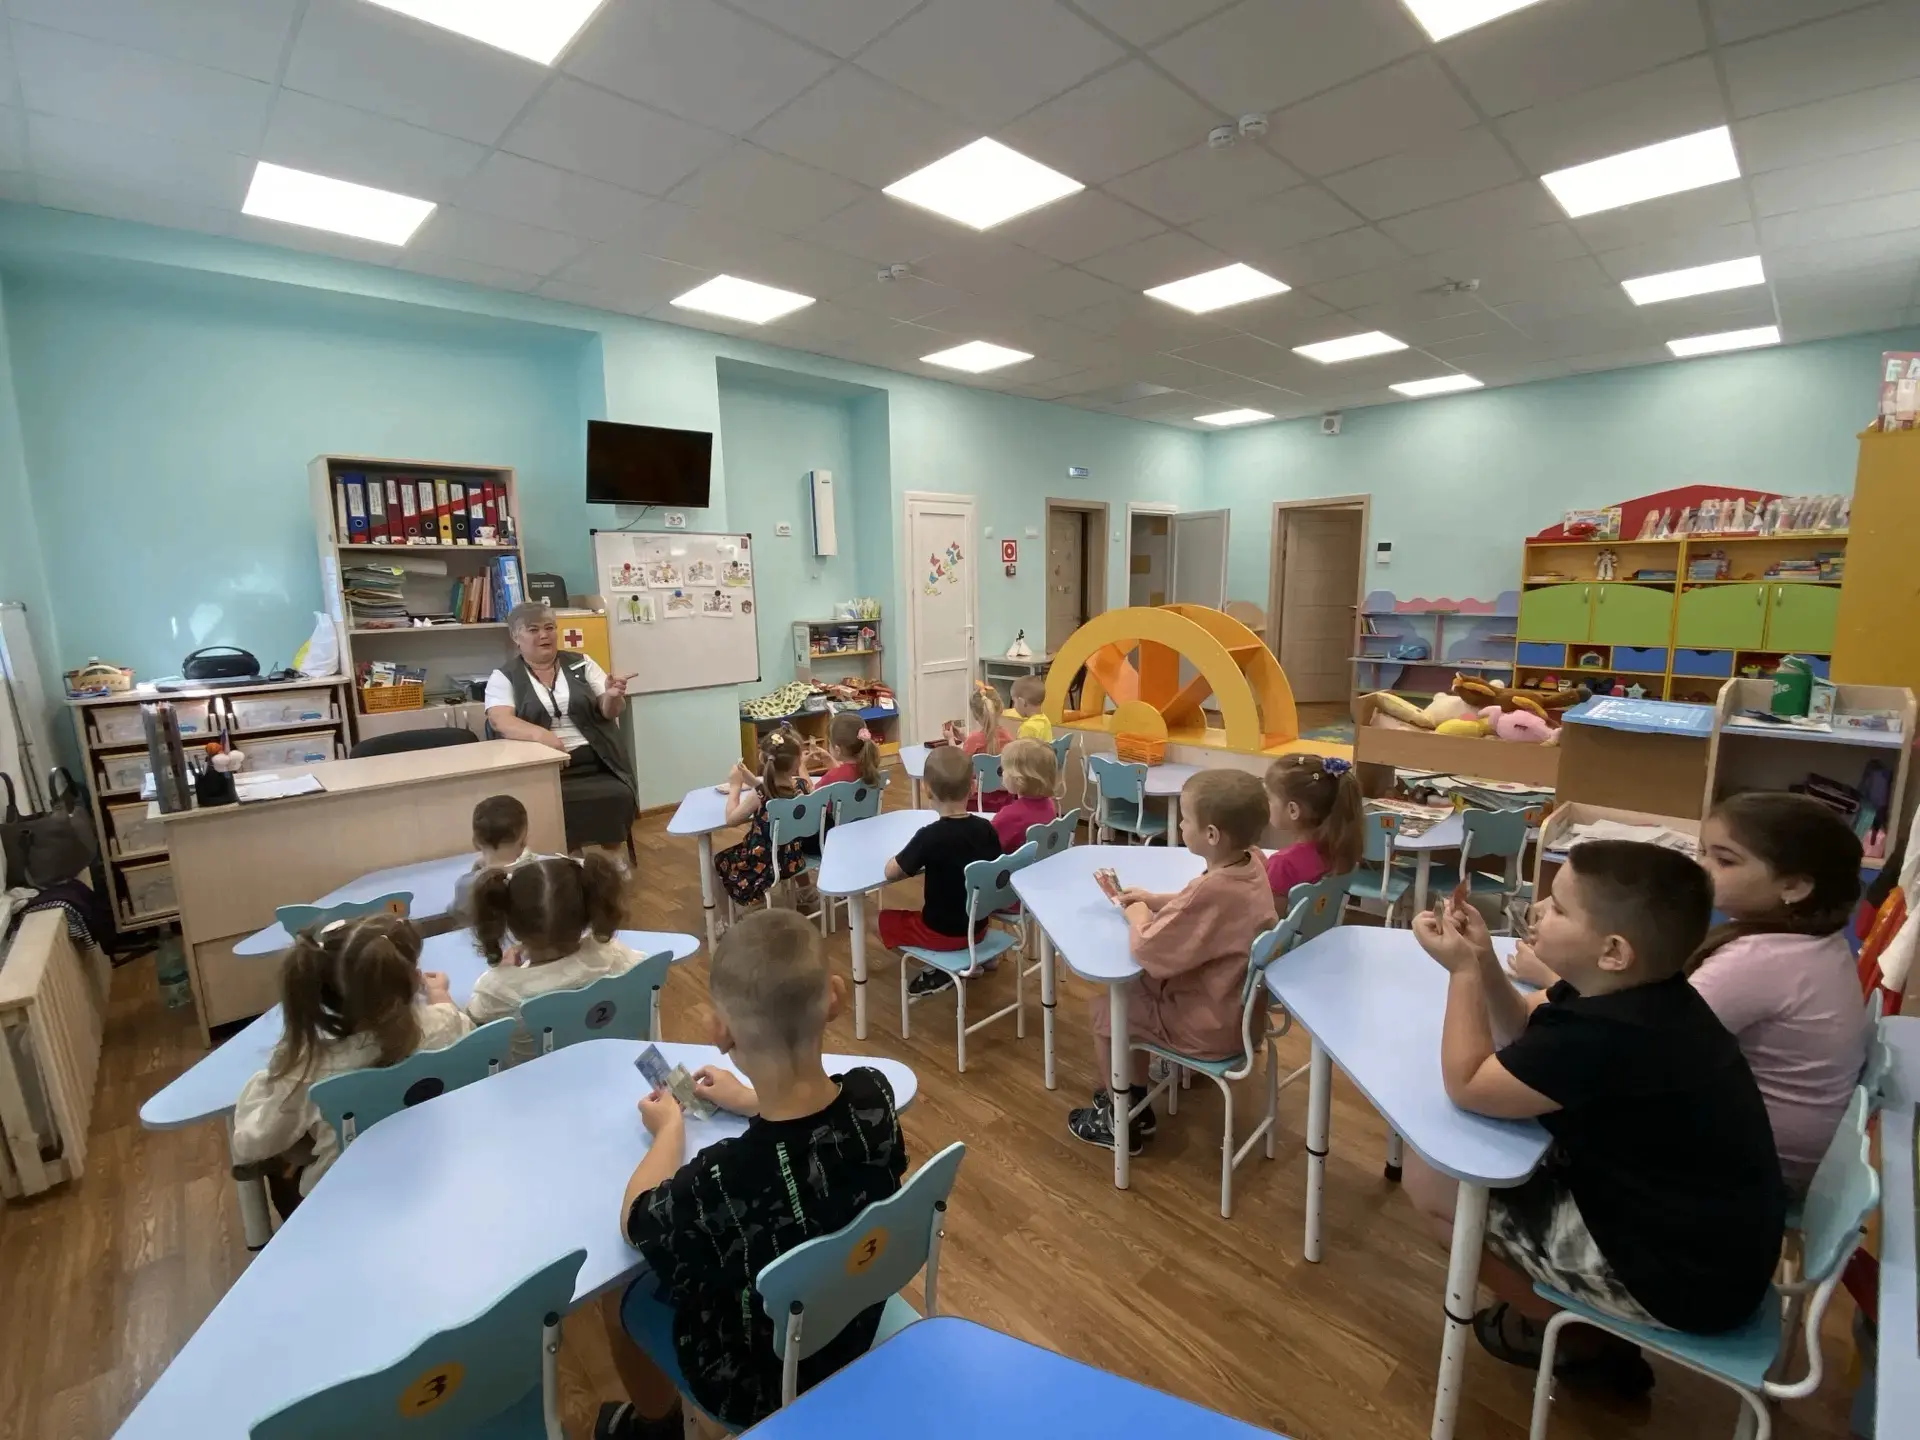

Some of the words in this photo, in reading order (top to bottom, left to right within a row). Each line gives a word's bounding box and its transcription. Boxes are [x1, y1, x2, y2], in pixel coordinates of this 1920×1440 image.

[594, 1007, 611, 1023] 2
[857, 1238, 877, 1266] 3
[416, 1373, 448, 1408] 3
